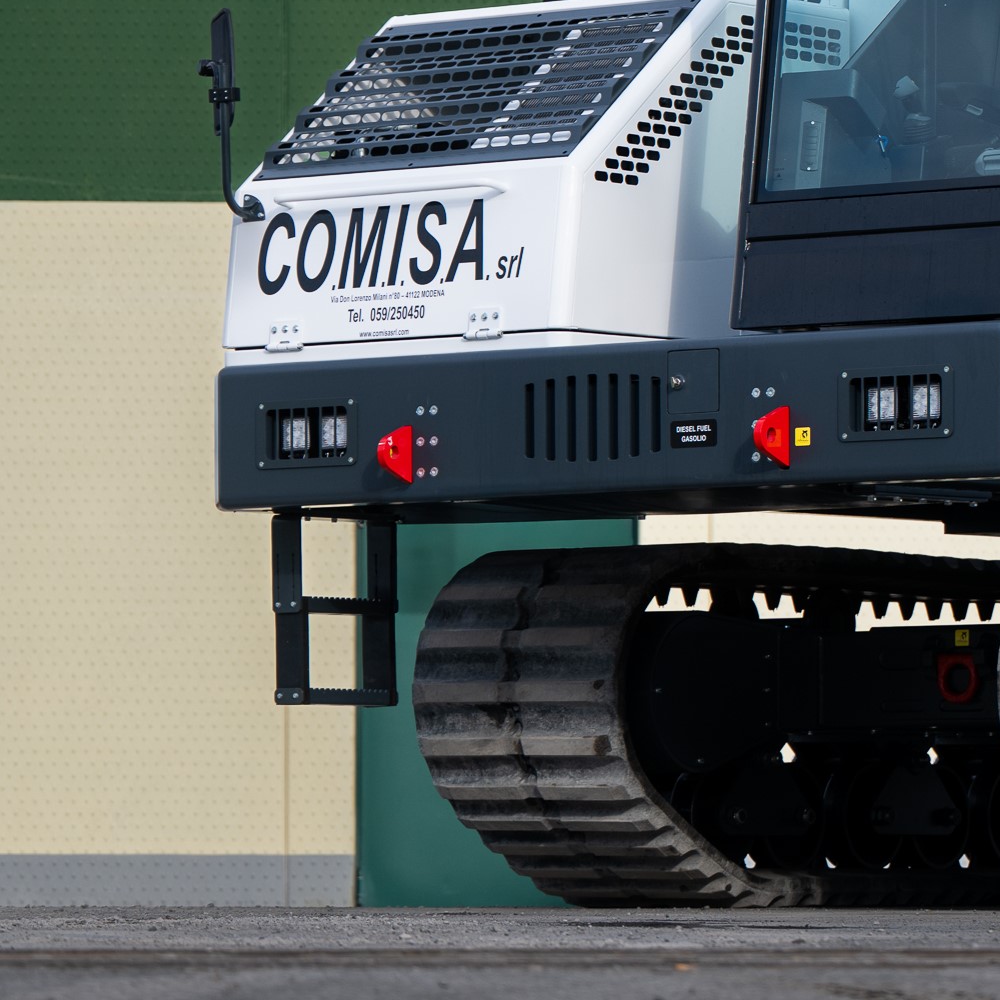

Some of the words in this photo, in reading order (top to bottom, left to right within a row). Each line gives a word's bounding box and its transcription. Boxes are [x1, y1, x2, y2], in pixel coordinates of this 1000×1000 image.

[340, 295, 350, 303] Don
[351, 294, 372, 302] Lorenzo
[372, 293, 388, 301] Milani
[405, 290, 420, 299] 41122
[421, 289, 445, 298] MODENA
[348, 308, 364, 323] Tel.
[370, 304, 425, 322] 059/250450
[359, 328, 410, 338] www.comisasrl.com
[676, 425, 696, 433] DIESEL
[697, 424, 711, 432] FUEL
[681, 434, 707, 443] GASOLIO
